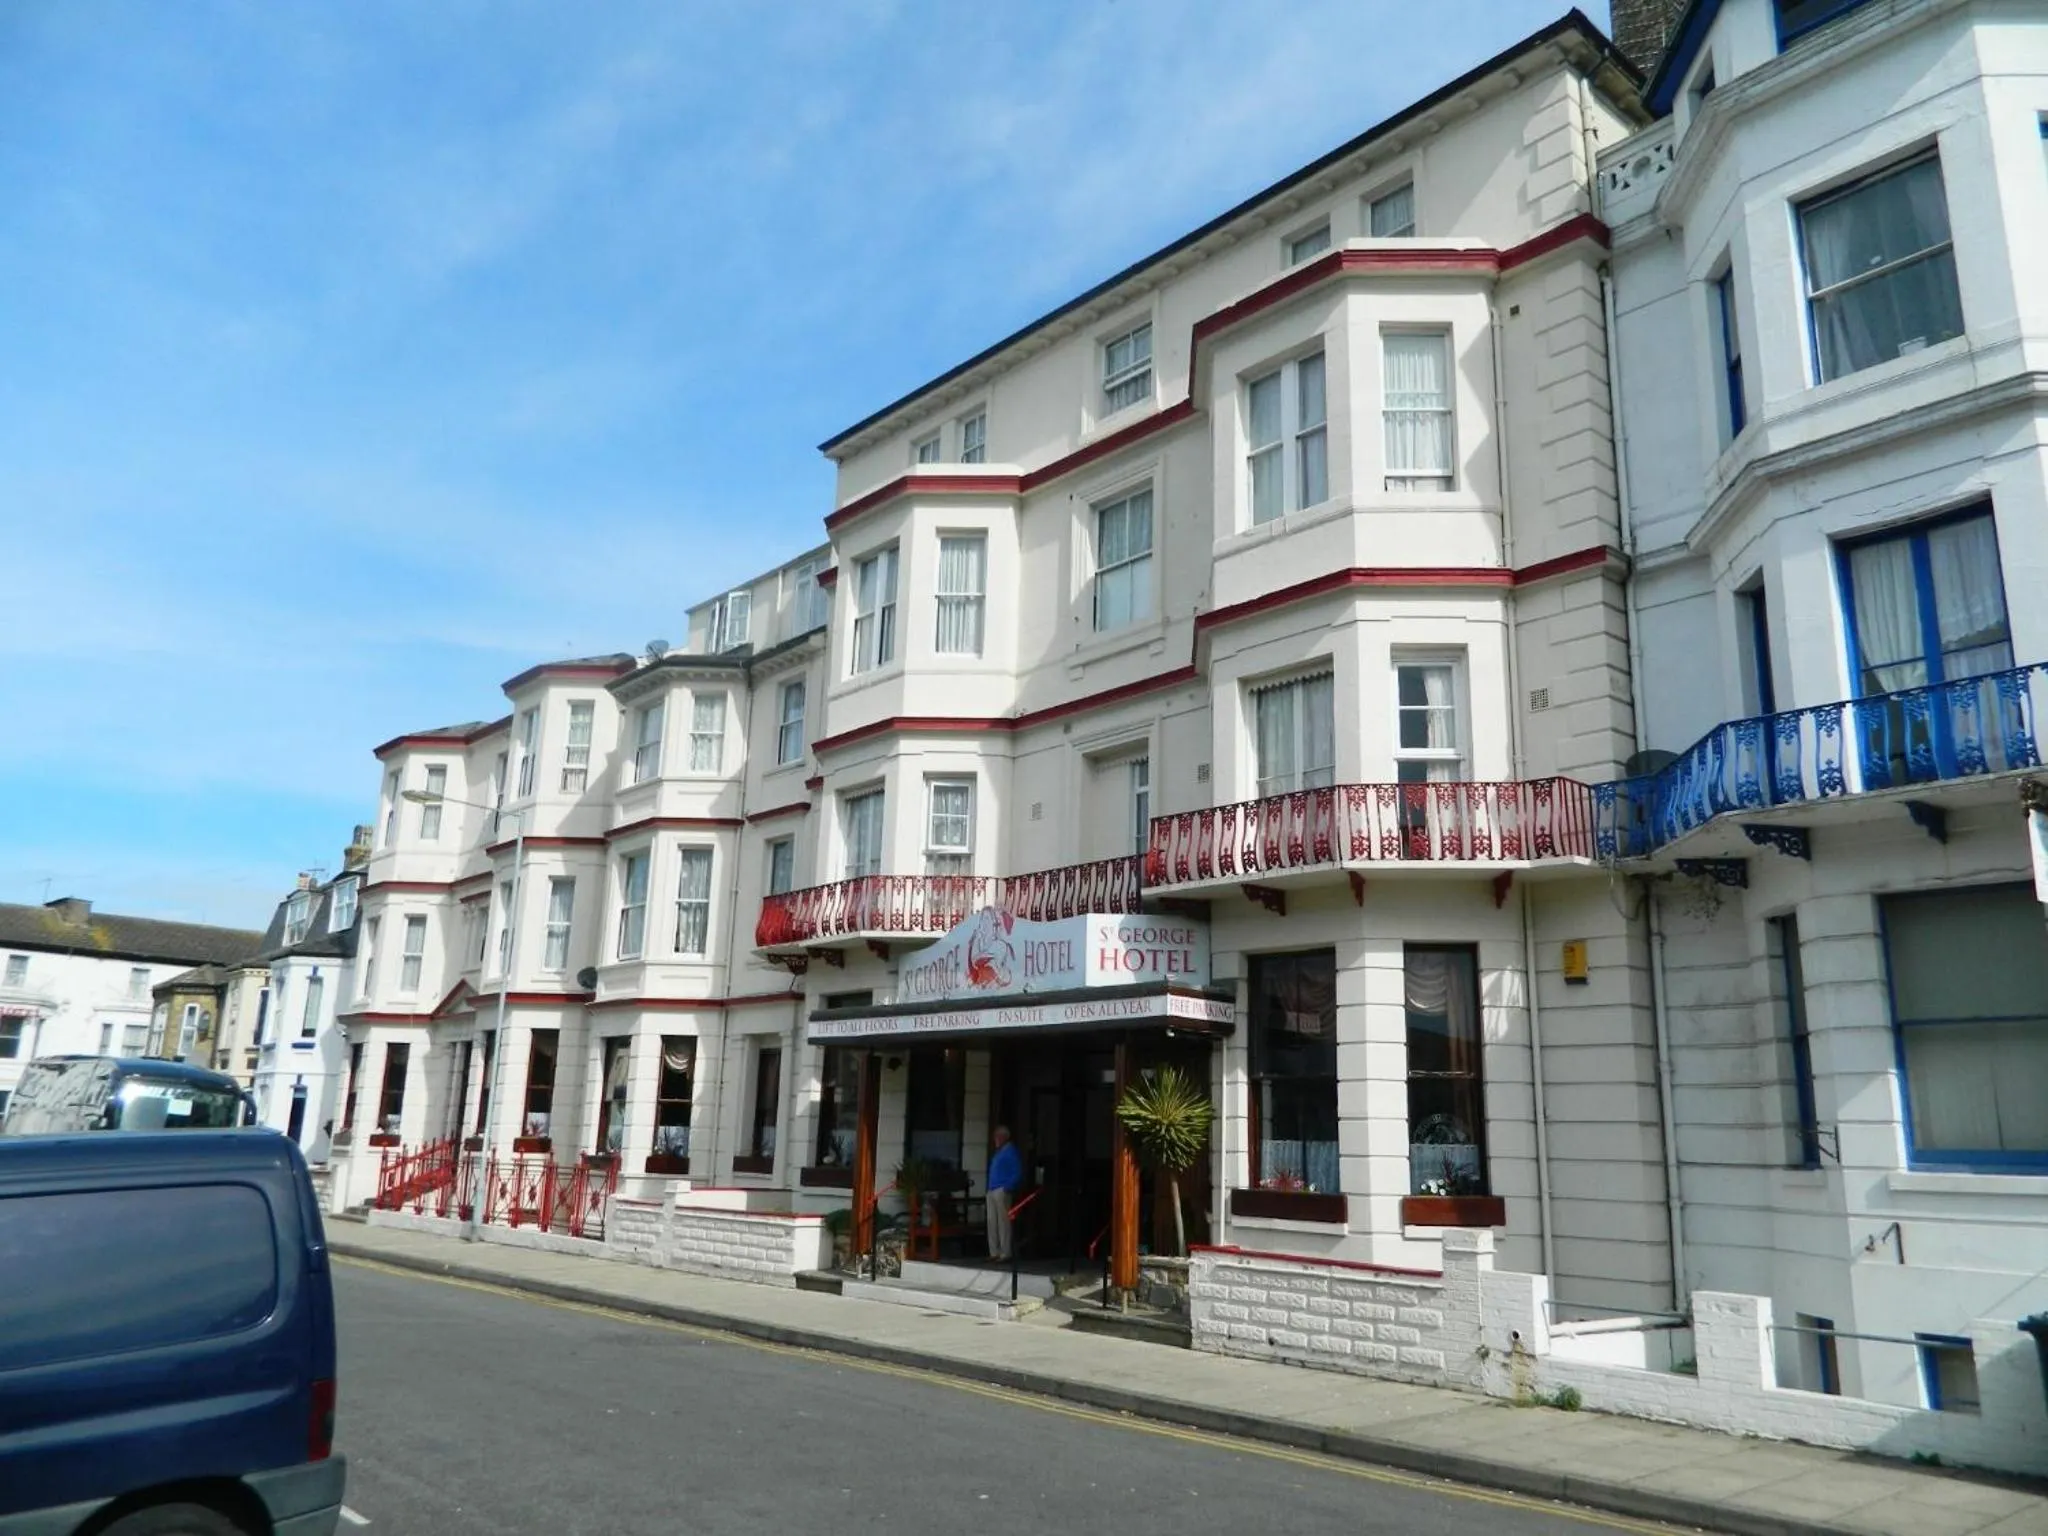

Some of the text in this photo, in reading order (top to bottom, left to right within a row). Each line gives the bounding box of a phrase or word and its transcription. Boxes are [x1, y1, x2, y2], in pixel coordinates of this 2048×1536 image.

[1118, 927, 1197, 944] GEORGE
[914, 944, 961, 995] GEORGE
[1024, 939, 1075, 977] HOTEL
[1100, 947, 1197, 973] HOTEL
[1064, 1000, 1152, 1019] OPEN ALL YEAR
[1170, 998, 1232, 1019] FREE PARKING
[865, 1018, 899, 1032] FLOORS
[913, 1014, 981, 1029] FREE PARKING
